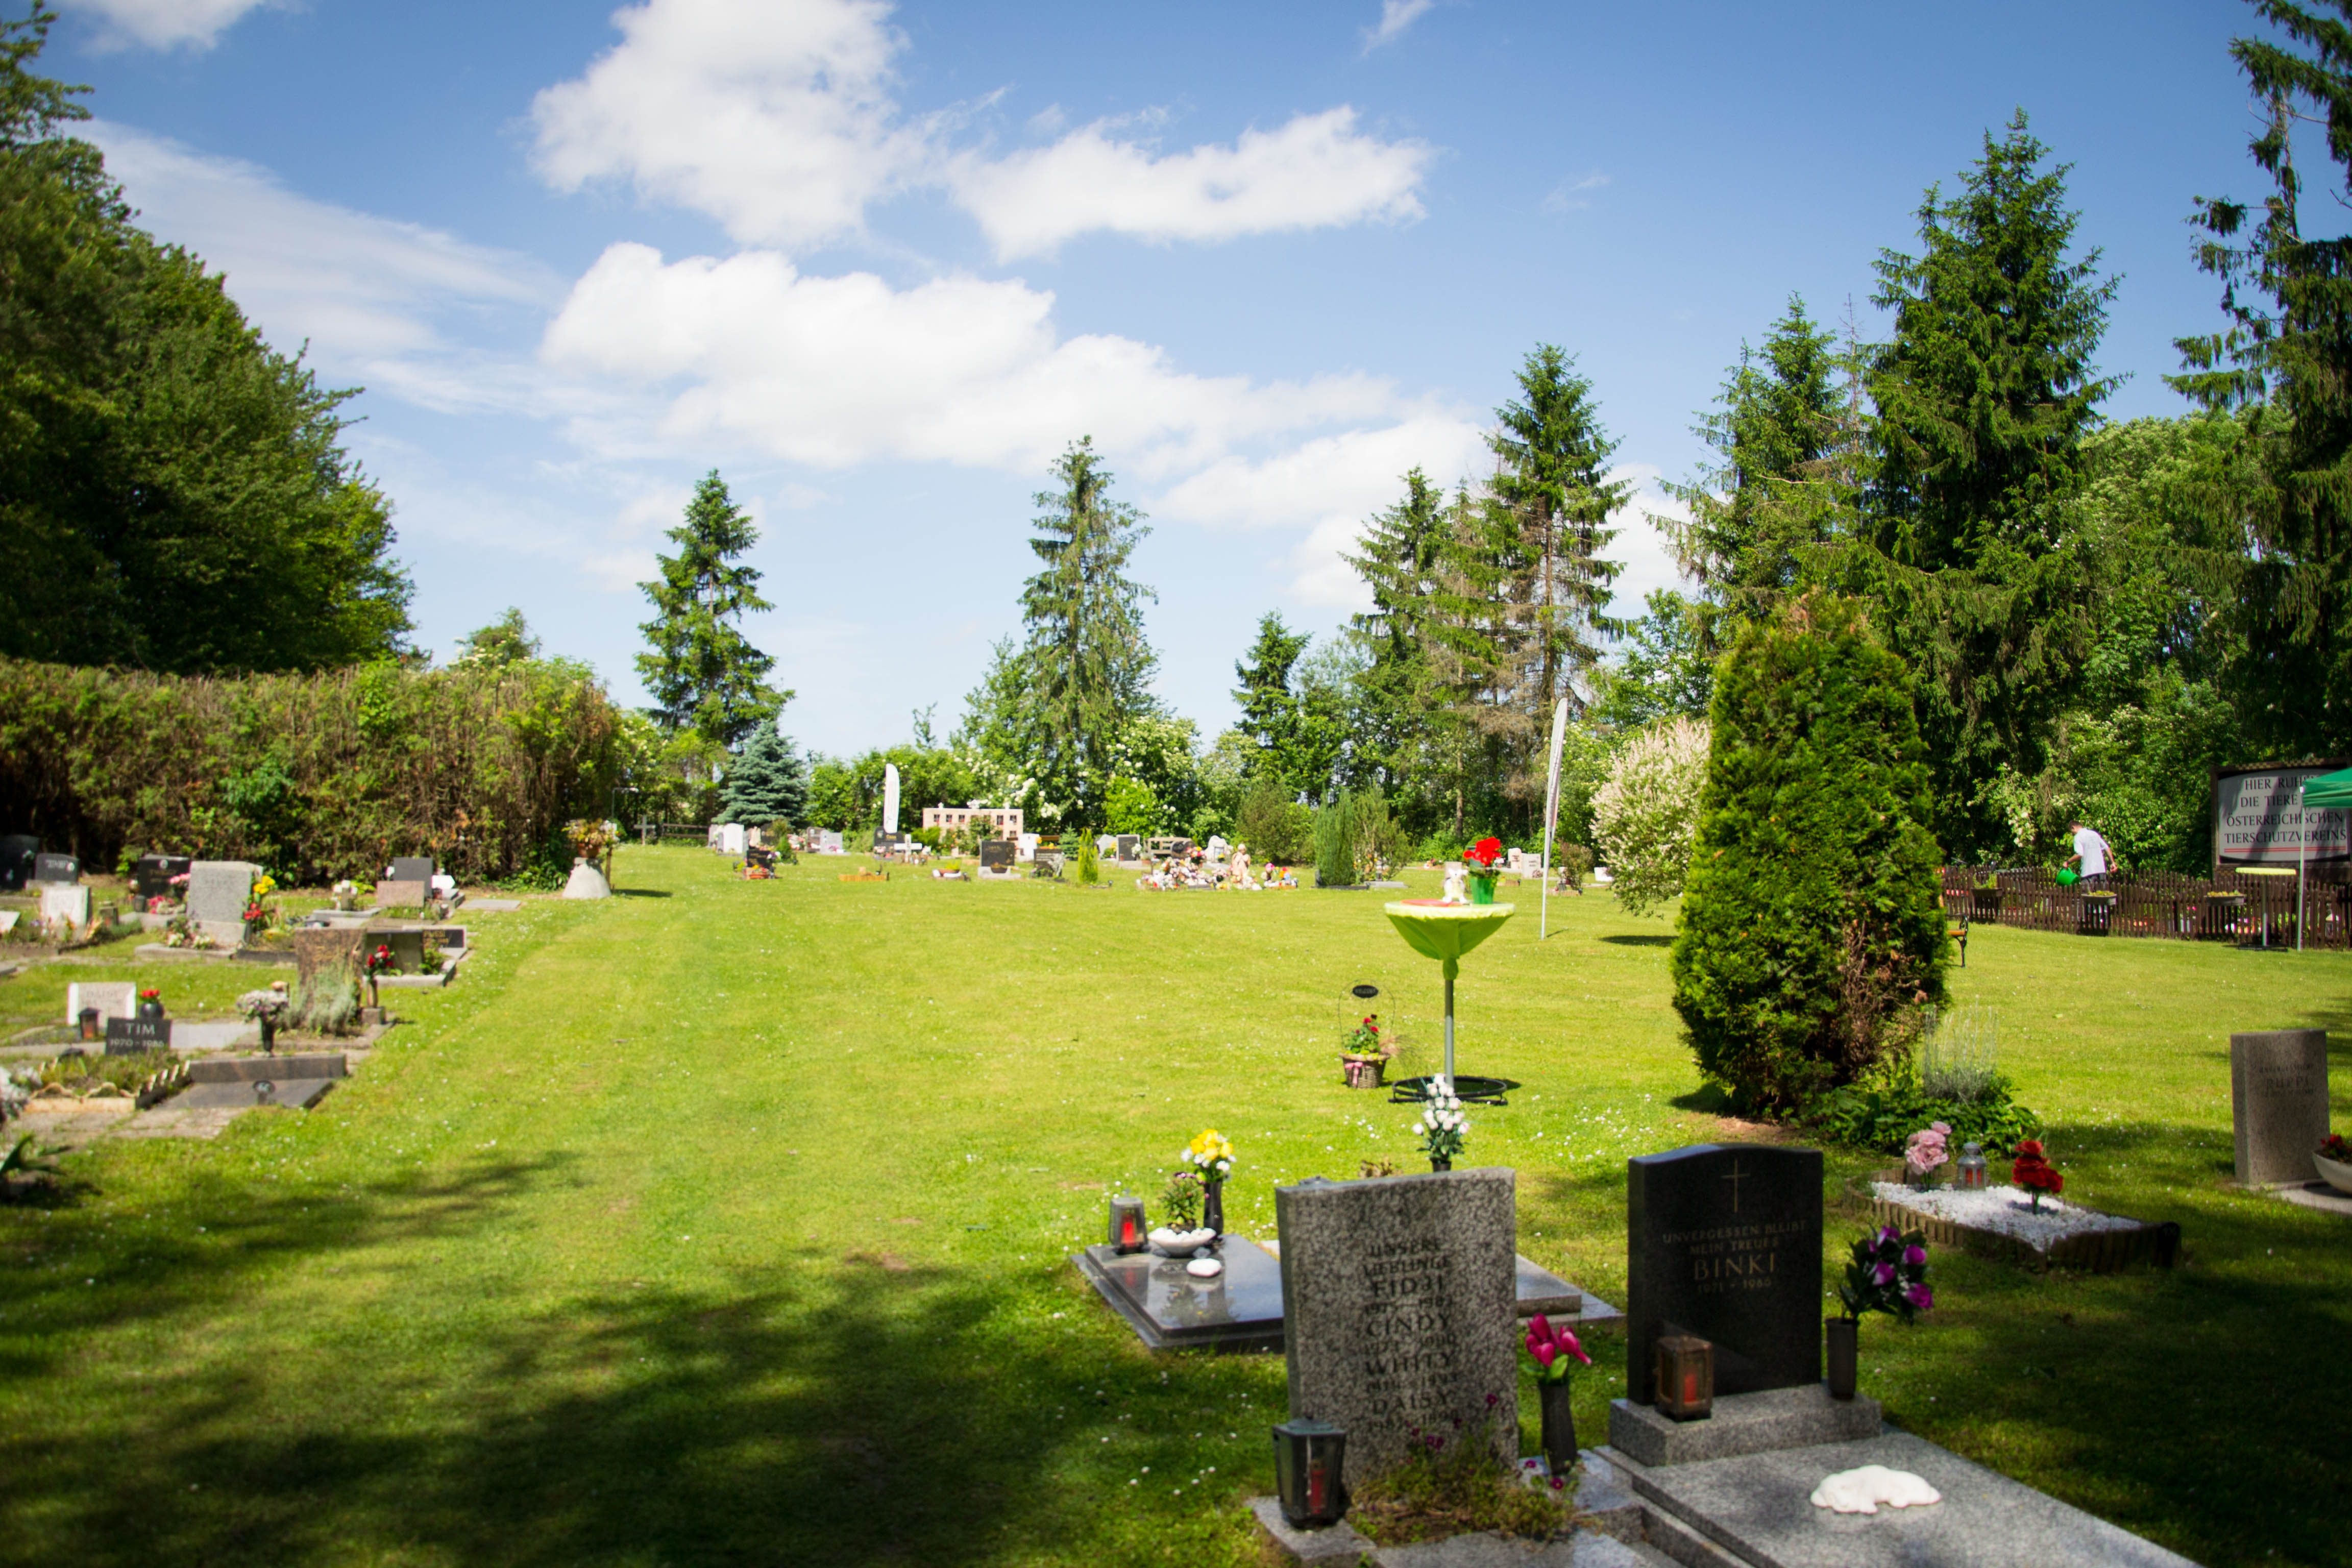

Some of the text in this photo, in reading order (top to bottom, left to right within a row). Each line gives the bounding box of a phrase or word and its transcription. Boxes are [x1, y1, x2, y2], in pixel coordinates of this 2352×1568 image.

[2245, 778, 2271, 790] HIER
[2240, 794, 2297, 807] DIE TIERE
[2226, 812, 2342, 826] ÖSTERREICHISCHEN
[2224, 829, 2346, 844] TIERSCHUTZVEREINS
[125, 1023, 155, 1036] TIM
[1662, 1225, 1760, 1243] UNVERGESSEN
[1689, 1242, 1724, 1255] MEIN
[1694, 1253, 1775, 1281] BINKI
[1366, 1313, 1452, 1336] CINDY
[1364, 1350, 1455, 1376] WHITY
[1373, 1388, 1457, 1414] DAISY
